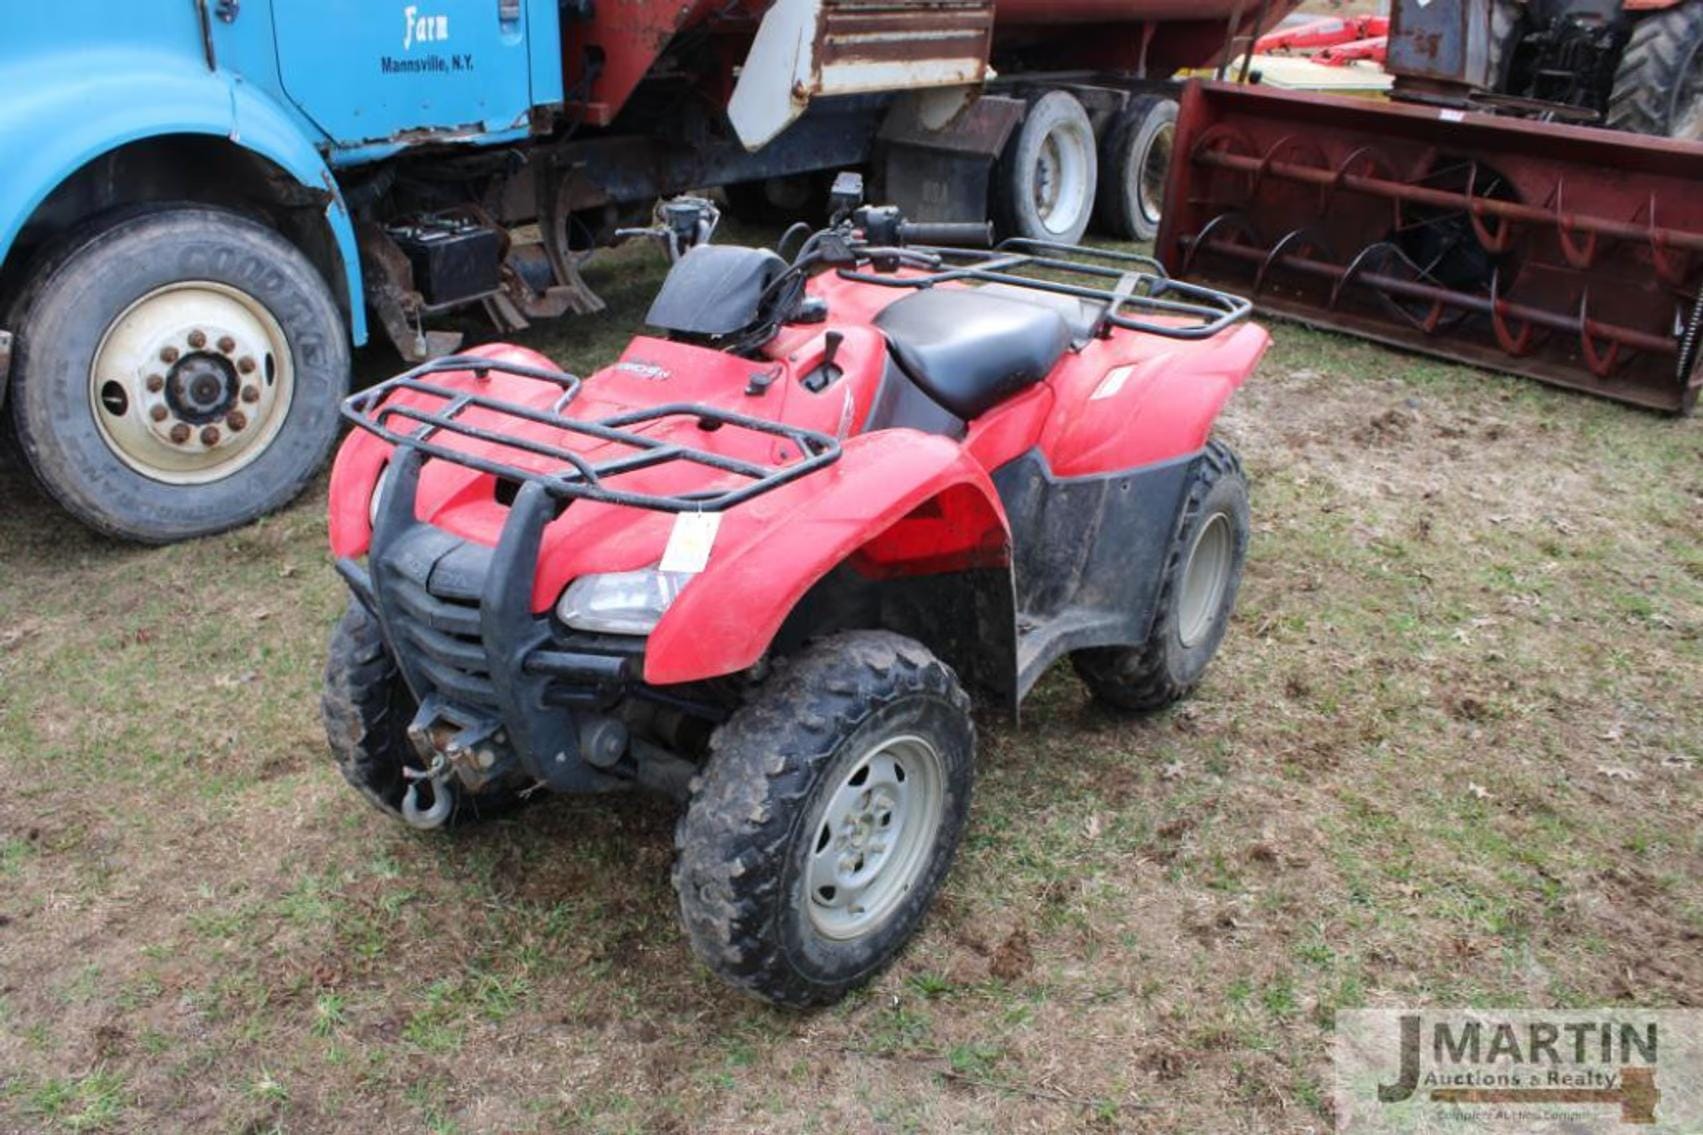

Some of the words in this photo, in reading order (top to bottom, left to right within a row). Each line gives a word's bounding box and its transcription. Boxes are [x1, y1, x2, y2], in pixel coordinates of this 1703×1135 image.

[403, 6, 448, 50] Farm
[381, 55, 449, 74] Mannsville,
[452, 54, 474, 72] N.Y.
